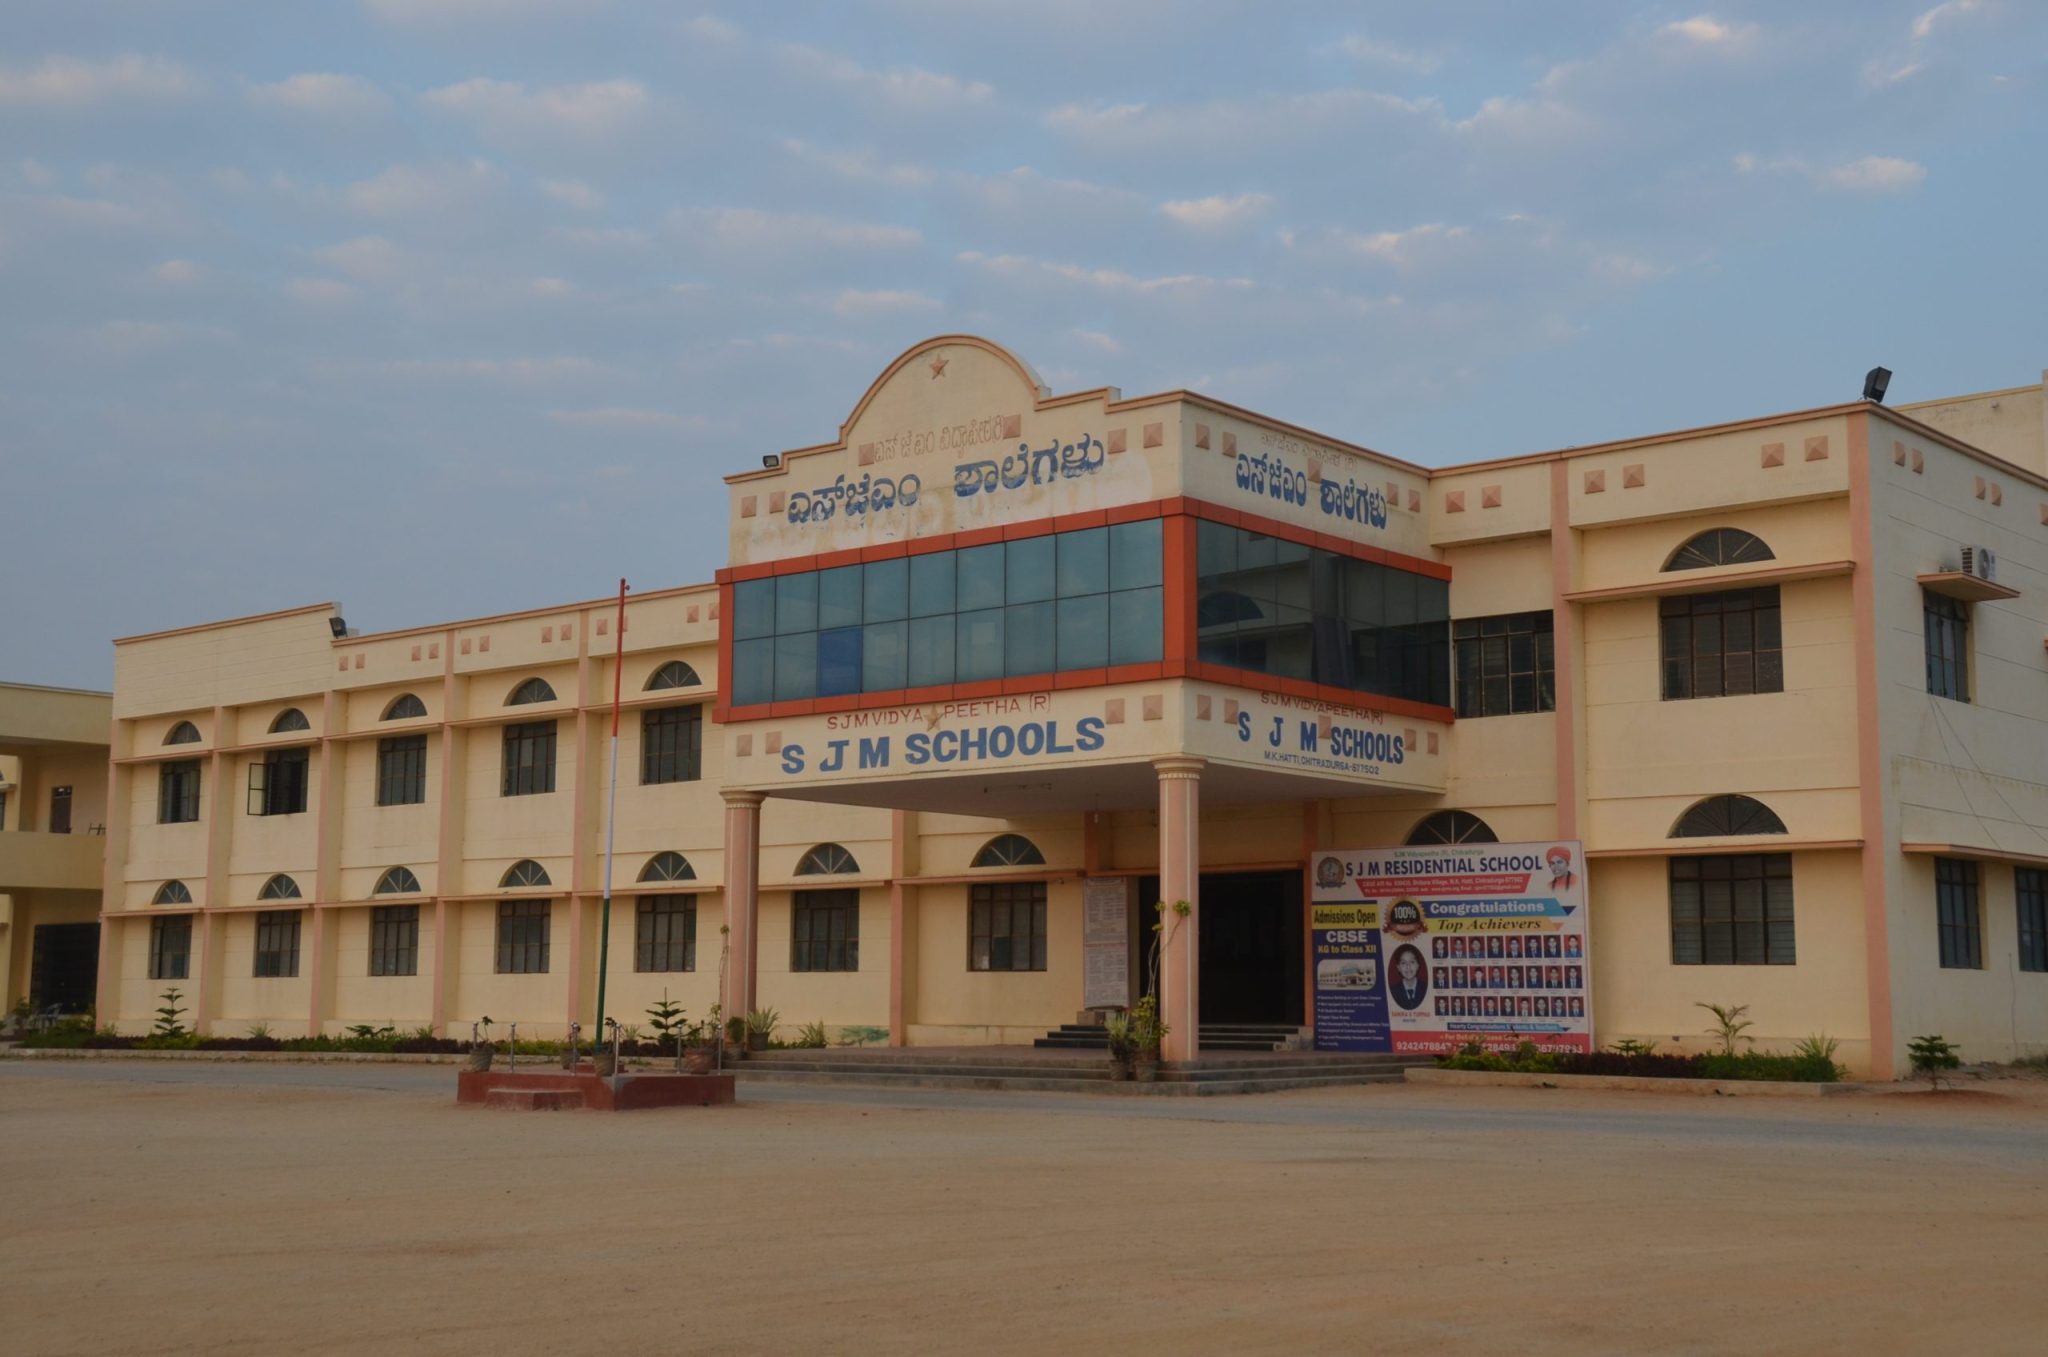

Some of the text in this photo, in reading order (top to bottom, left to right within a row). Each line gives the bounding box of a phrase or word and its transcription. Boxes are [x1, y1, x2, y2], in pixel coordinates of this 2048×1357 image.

[1320, 478, 1387, 529] ಶಾಲೆಗಳು
[943, 698, 1021, 720] PEETHA
[905, 717, 1105, 765] SCHOOLS
[1330, 726, 1404, 765] SCHOOLS
[1385, 857, 1475, 875] RESIDENTIAL
[1479, 855, 1542, 873] SCHOOL
[1314, 909, 1376, 925] Admissions Open
[1430, 901, 1544, 916] Congratulations
[1438, 918, 1542, 932] Top Achievers
[1326, 930, 1368, 943] CBSE
[1341, 945, 1363, 953] Class
